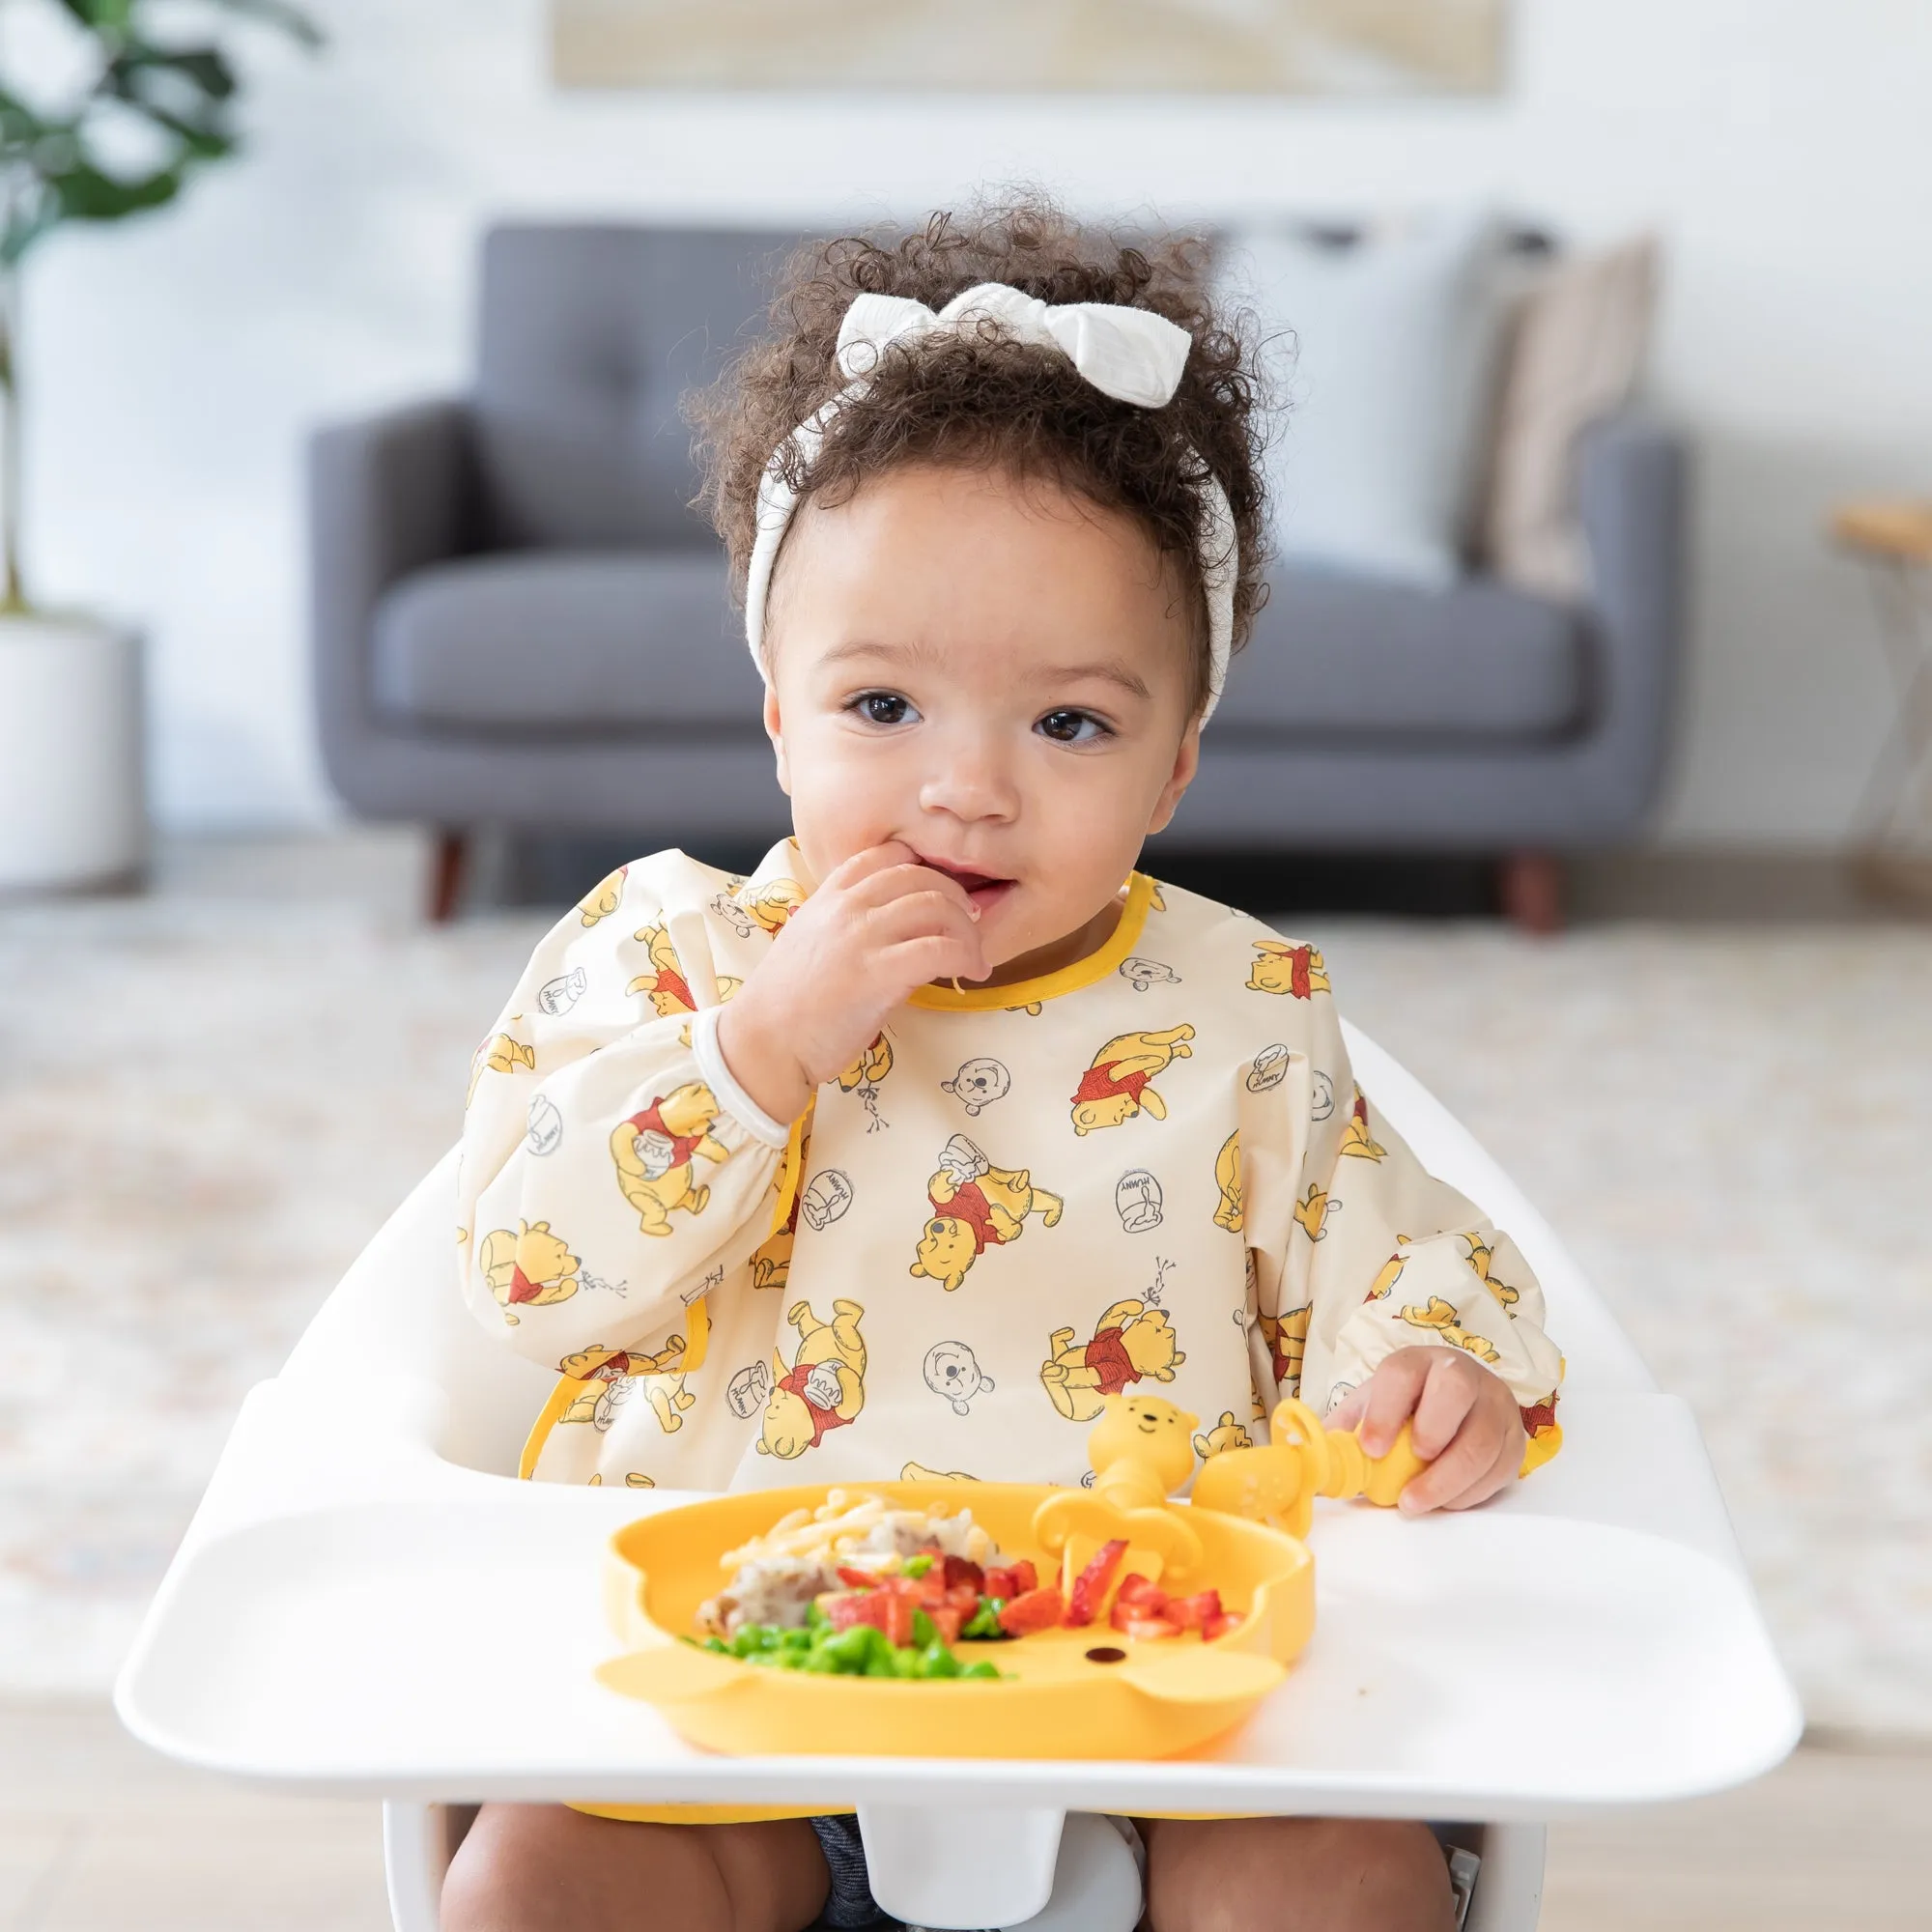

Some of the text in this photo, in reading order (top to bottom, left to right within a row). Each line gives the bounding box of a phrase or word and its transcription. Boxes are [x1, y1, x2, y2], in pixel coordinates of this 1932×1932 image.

[826, 1173, 849, 1201] HUNNY
[1121, 1176, 1150, 1192] HUNNY
[730, 1387, 748, 1415] HUNNY
